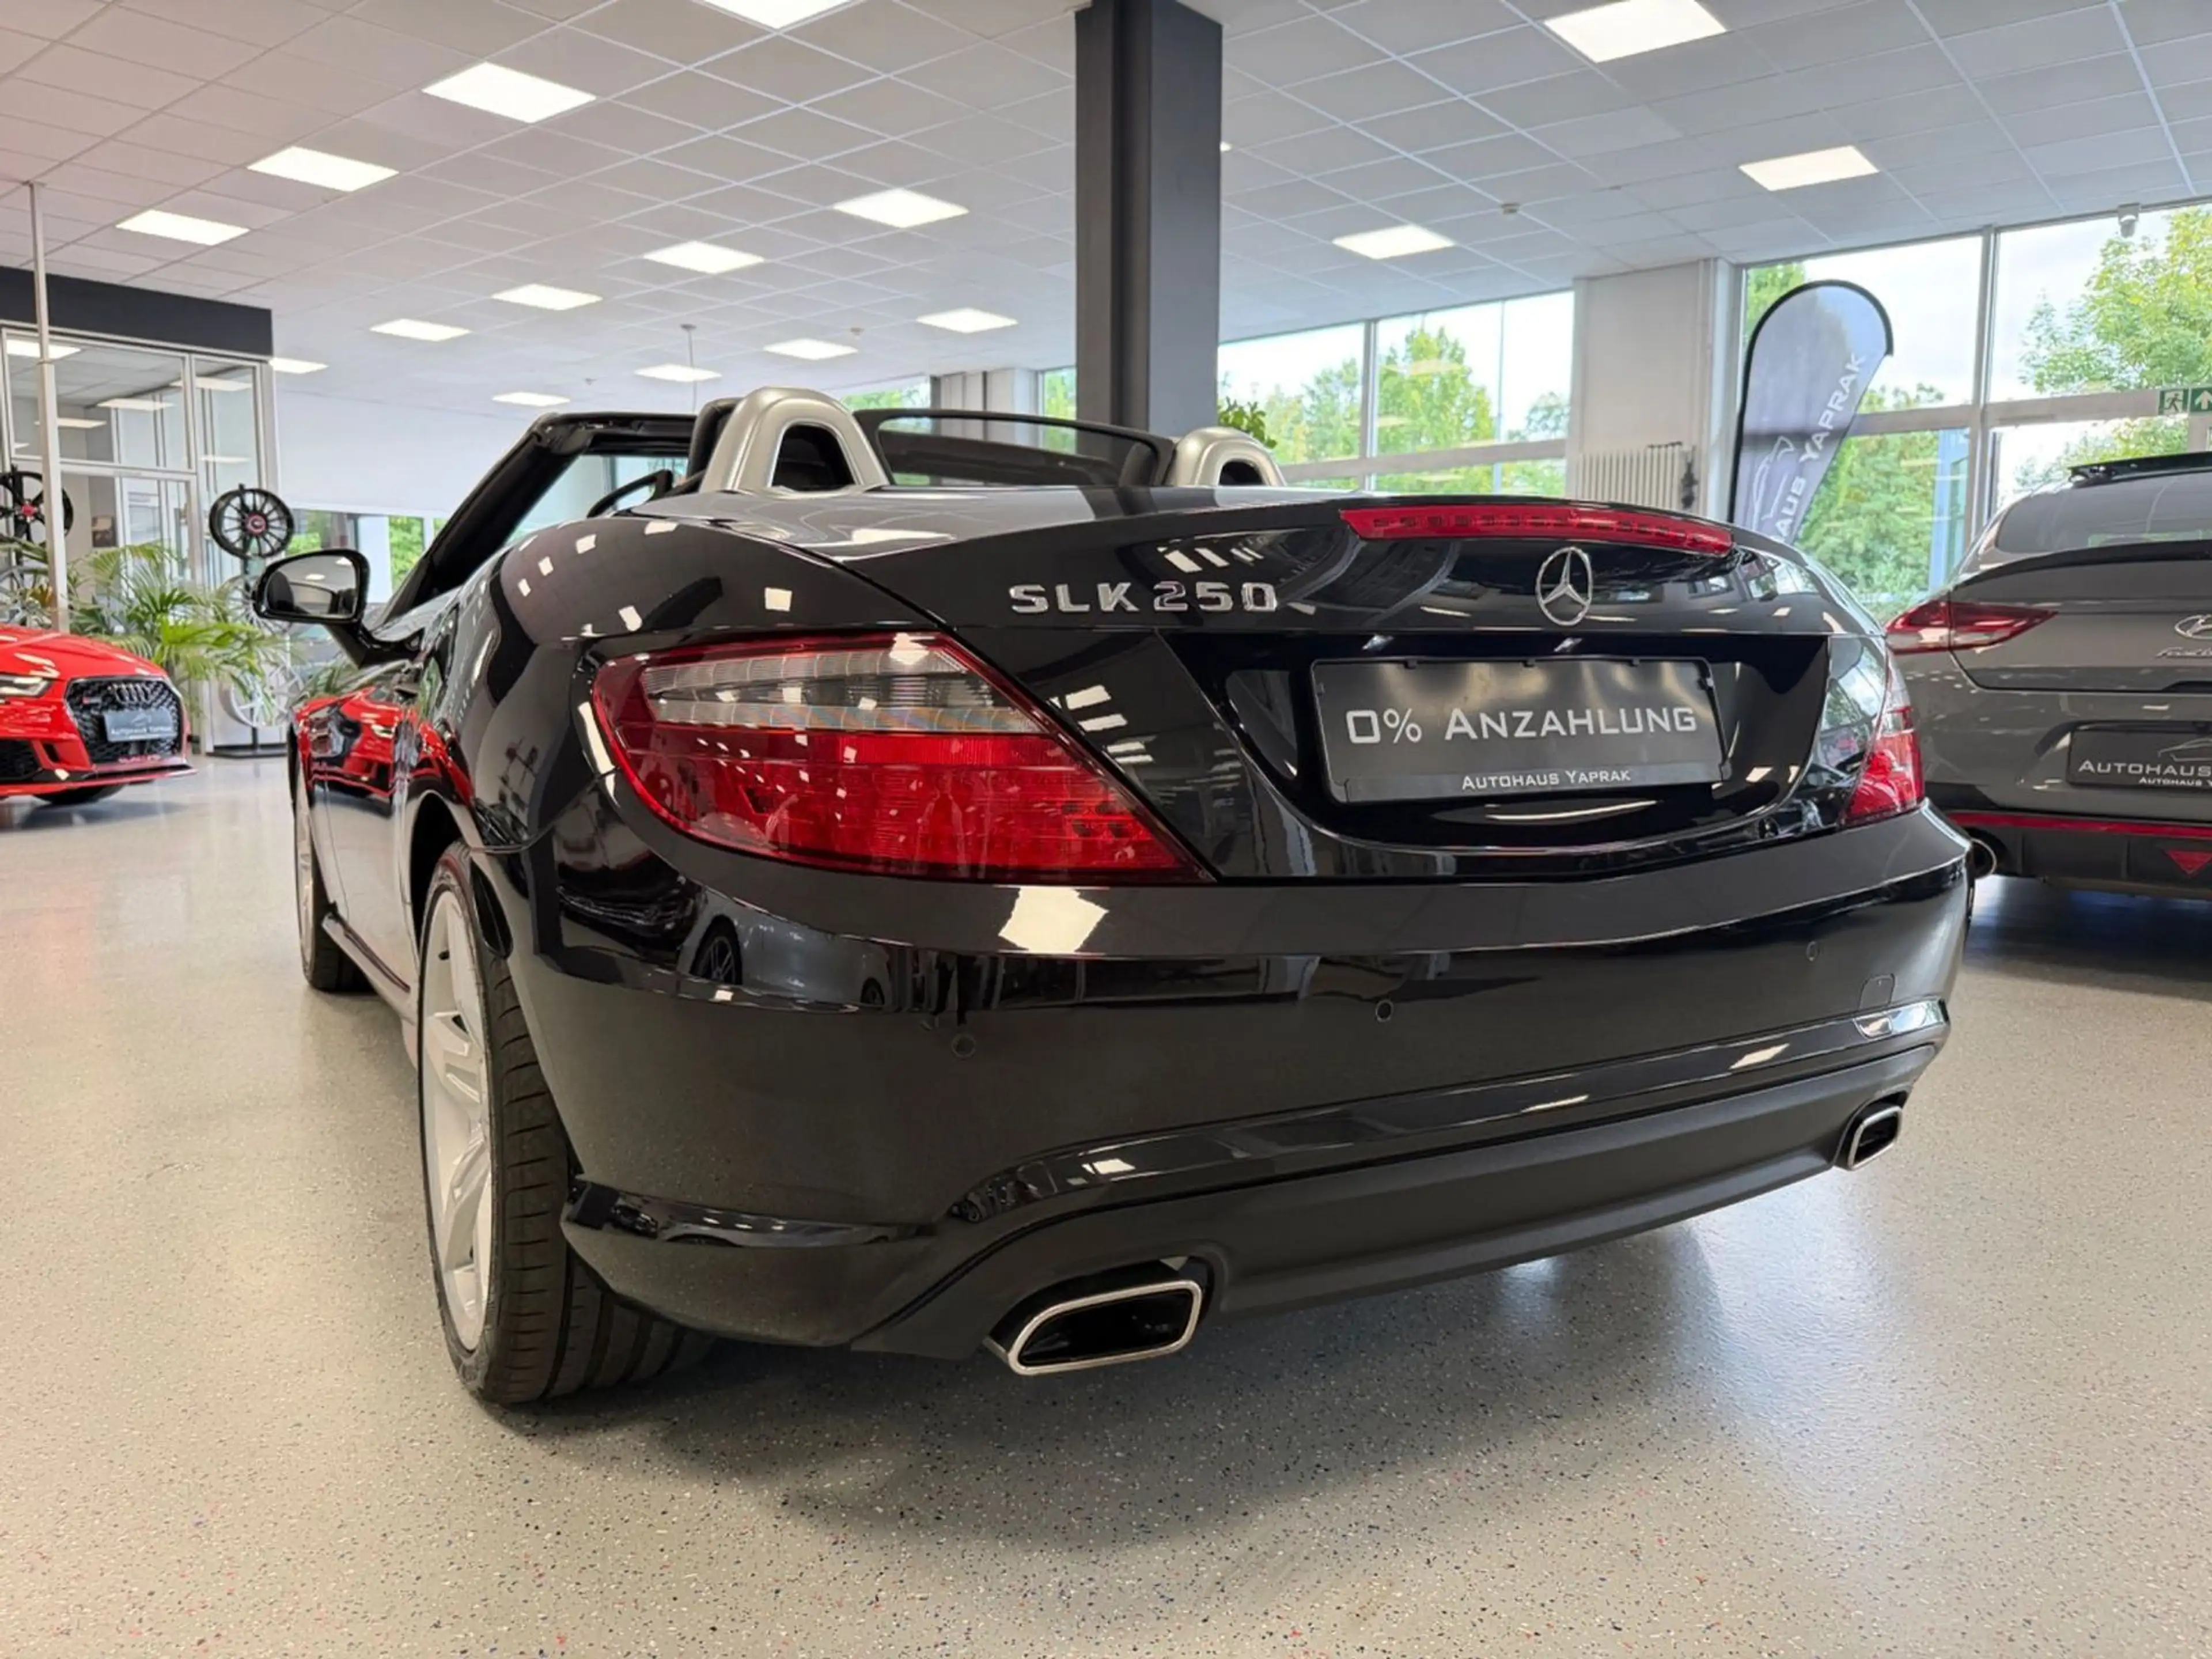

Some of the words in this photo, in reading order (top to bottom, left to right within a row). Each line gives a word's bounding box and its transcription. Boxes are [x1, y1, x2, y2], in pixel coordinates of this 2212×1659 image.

[1798, 352, 1866, 463] YAPRAK
[1009, 582, 1139, 613] SLK
[1153, 581, 1277, 612] 250
[1346, 708, 1423, 744] 0%
[1445, 706, 1698, 741] ANZAHLUNG
[1462, 771, 1560, 790] AUTOHAUS
[1566, 769, 1631, 785] YAPRAK
[2078, 759, 2212, 777] AUTOHAUS
[2139, 777, 2202, 786] AUTOHAUS
